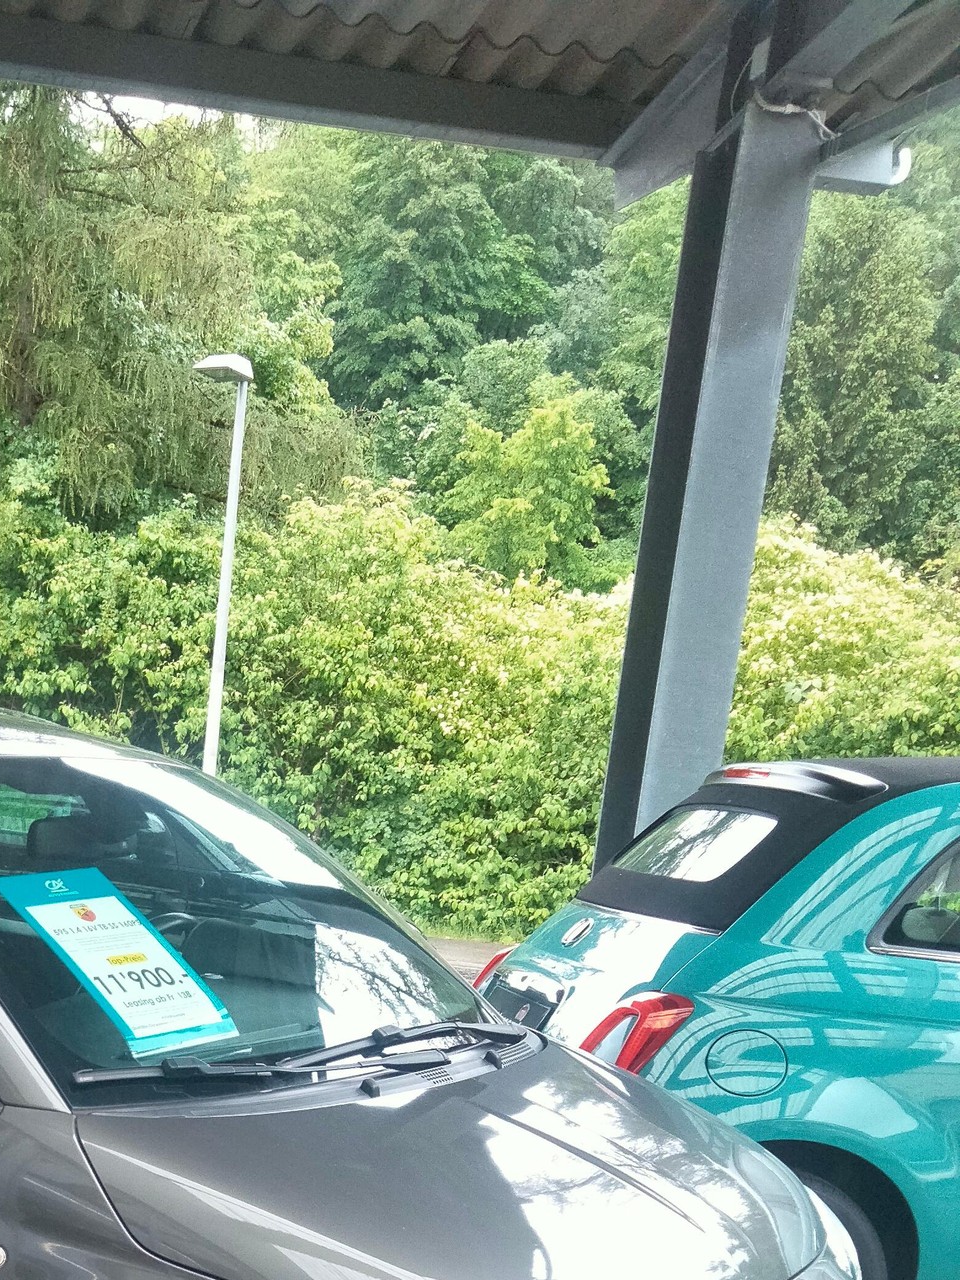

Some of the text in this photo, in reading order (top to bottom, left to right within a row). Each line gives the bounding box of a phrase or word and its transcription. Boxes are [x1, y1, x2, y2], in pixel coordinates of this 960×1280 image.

[52, 927, 69, 936] 595
[69, 926, 83, 934] 1.4
[83, 924, 98, 933] 16V
[93, 967, 189, 995] 11'900.-
[123, 998, 155, 1008] Leasing
[156, 995, 167, 1003] ab
